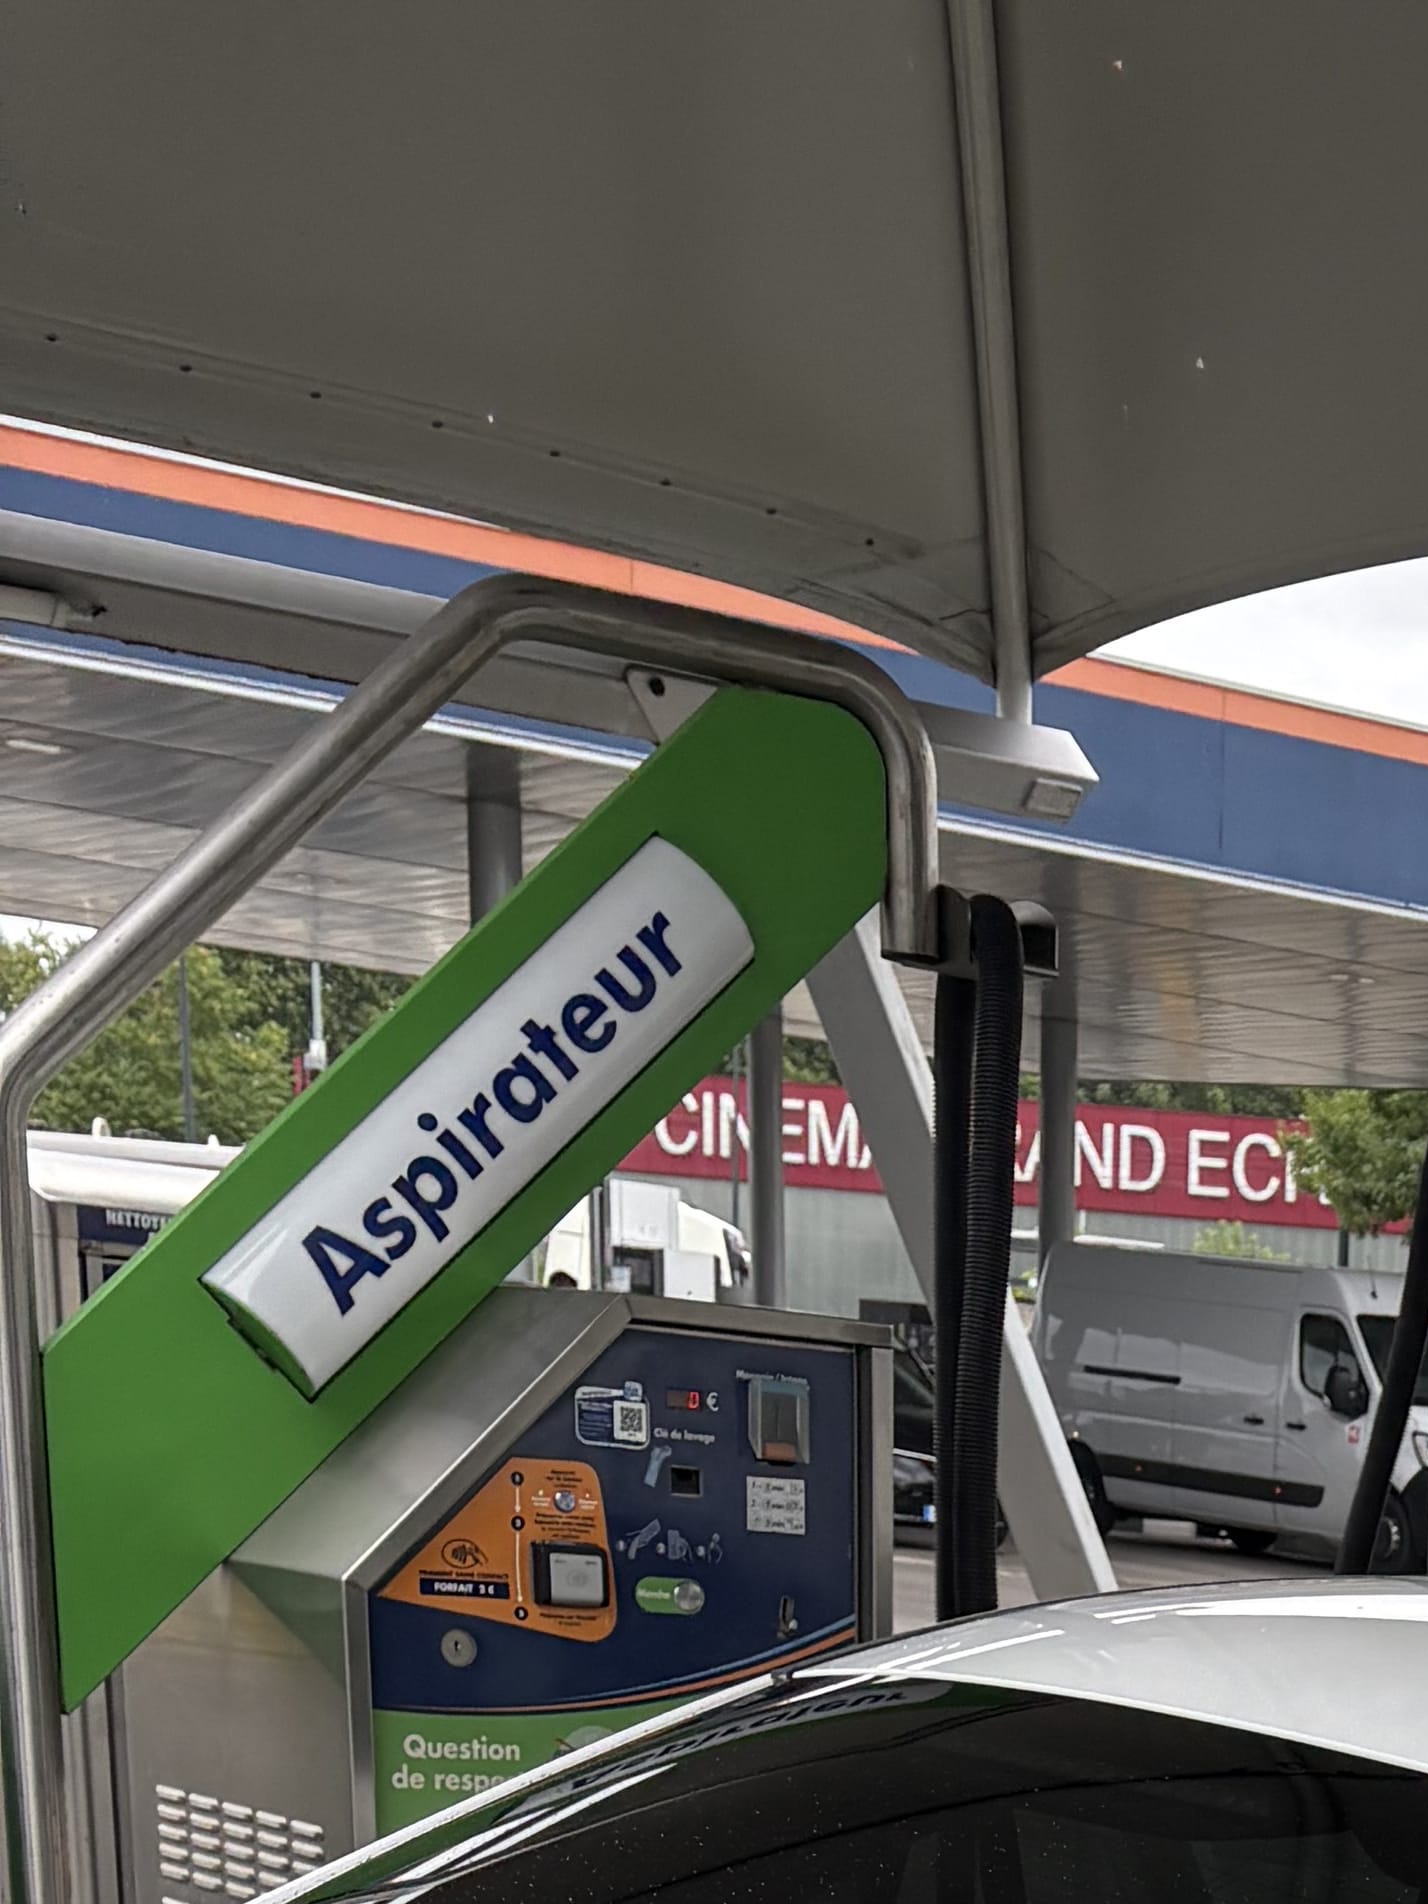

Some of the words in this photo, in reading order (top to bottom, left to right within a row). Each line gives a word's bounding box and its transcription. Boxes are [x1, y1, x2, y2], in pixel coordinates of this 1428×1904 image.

[302, 910, 682, 1316] Aspirateur
[654, 1091, 872, 1169] CINEM
[706, 1391, 720, 1412] €
[403, 1734, 521, 1761] Question
[391, 1763, 425, 1789] de
